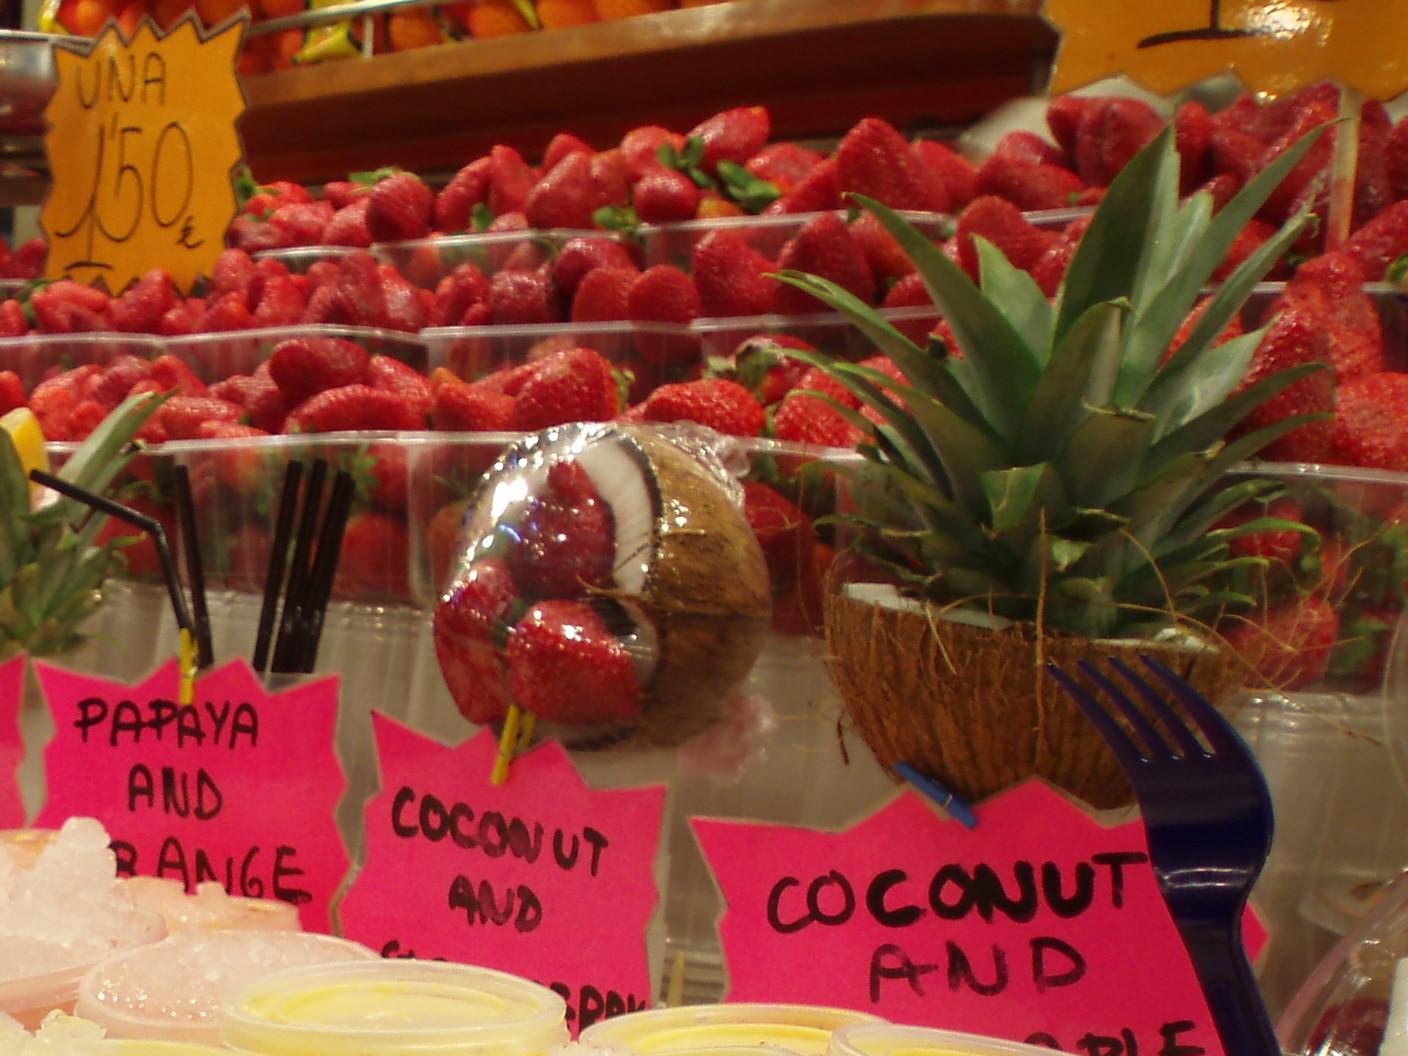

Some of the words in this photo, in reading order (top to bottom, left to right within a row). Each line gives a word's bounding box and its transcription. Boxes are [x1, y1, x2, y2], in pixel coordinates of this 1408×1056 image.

[76, 52, 166, 109] UNA
[74, 697, 259, 750] PAPAYA
[127, 762, 223, 820] AND
[391, 785, 609, 878] COCONUT
[108, 835, 313, 906] RANGE
[766, 850, 1148, 935] COCONUT
[448, 873, 543, 933] AND
[868, 934, 1087, 1003] AND
